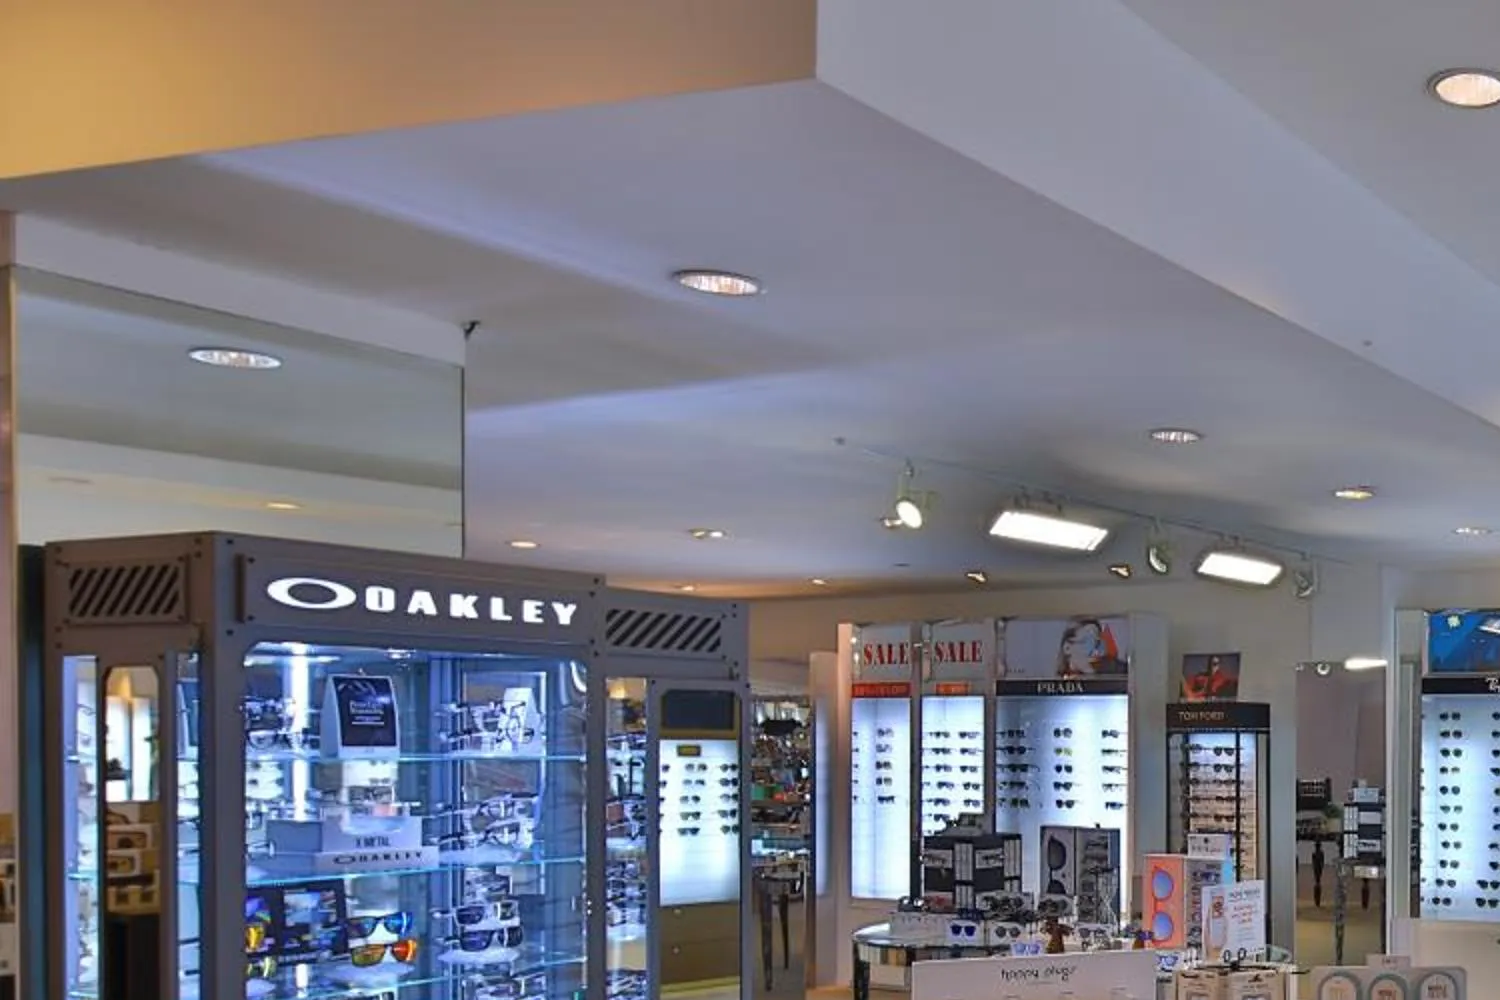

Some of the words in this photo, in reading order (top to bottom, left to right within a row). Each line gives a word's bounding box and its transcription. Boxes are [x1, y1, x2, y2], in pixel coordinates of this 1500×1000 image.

[365, 585, 577, 626] OAKLEY
[864, 642, 909, 665] SALE
[935, 640, 983, 663] SALE
[1037, 681, 1085, 693] PRADA
